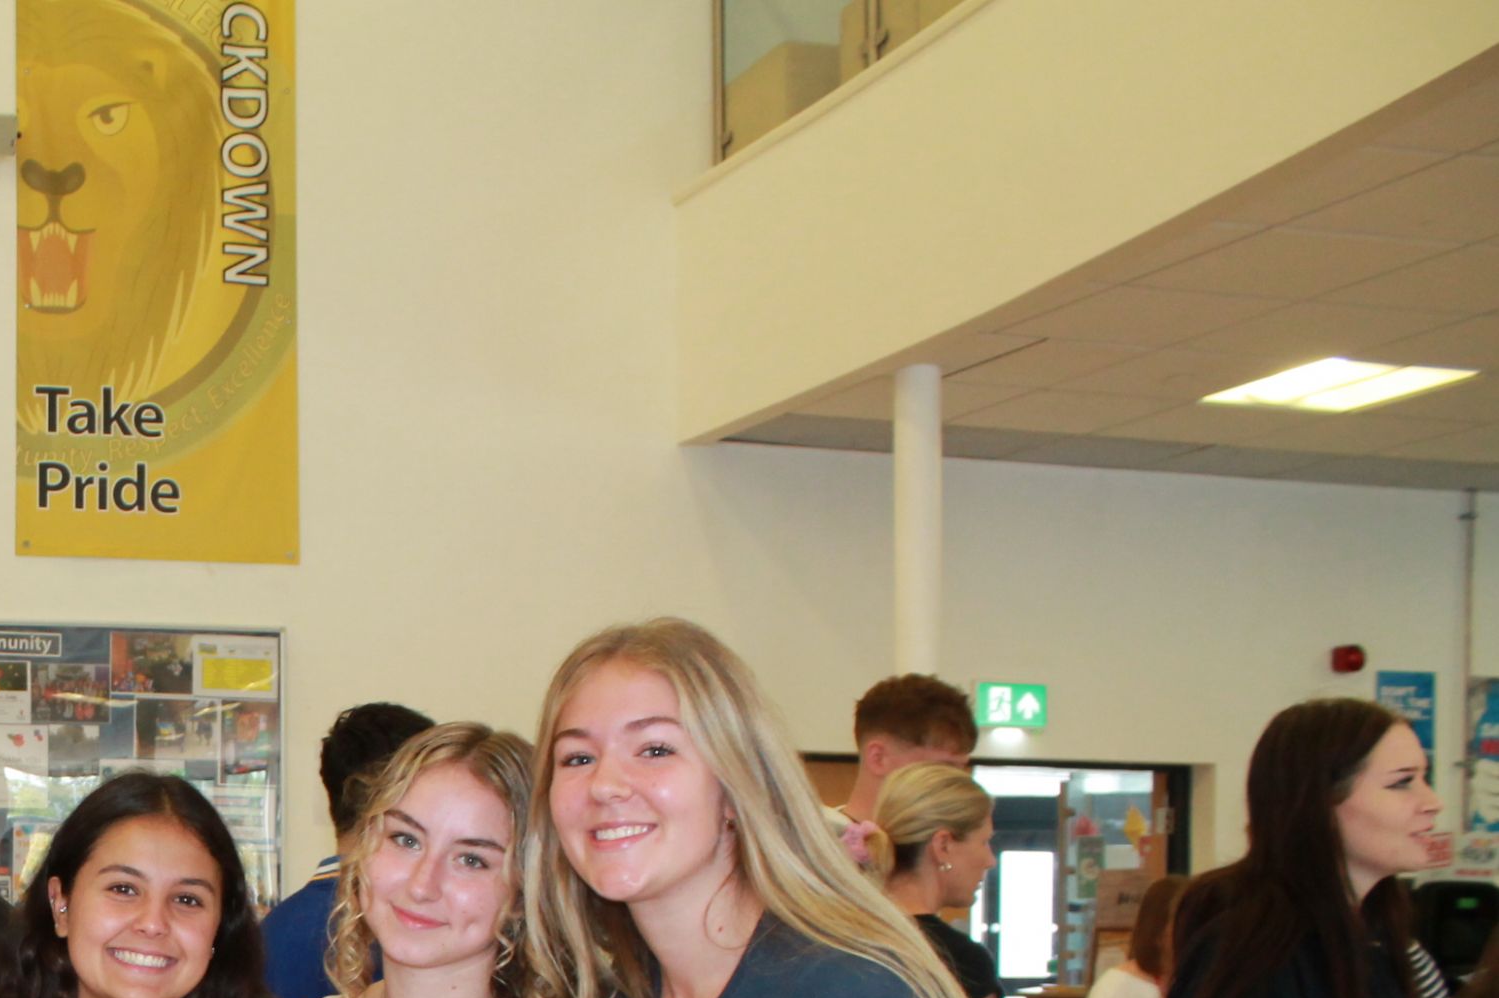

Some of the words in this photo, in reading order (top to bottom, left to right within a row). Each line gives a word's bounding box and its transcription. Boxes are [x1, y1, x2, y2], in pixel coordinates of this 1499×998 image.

[220, 1, 269, 287] CKDOWN
[206, 293, 291, 411] Excellence
[33, 384, 165, 439] Take
[36, 460, 182, 515] Pride
